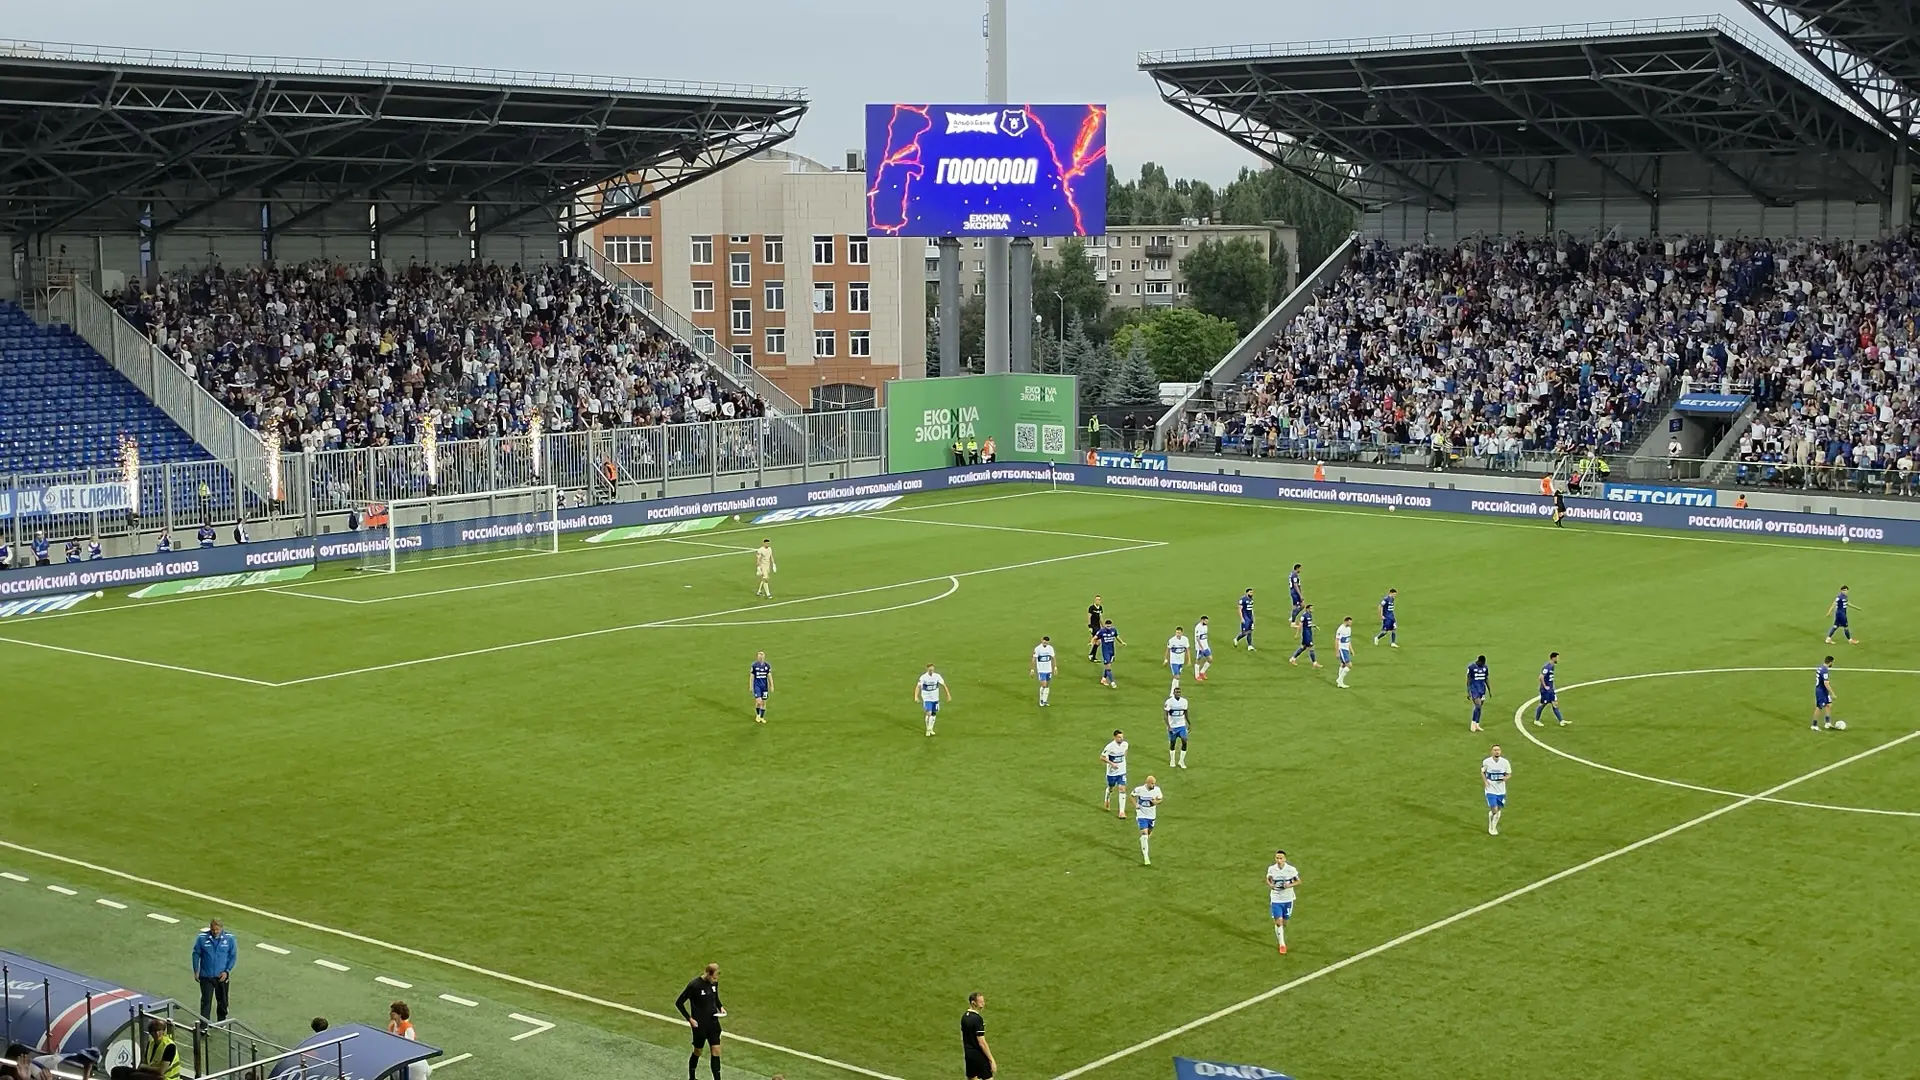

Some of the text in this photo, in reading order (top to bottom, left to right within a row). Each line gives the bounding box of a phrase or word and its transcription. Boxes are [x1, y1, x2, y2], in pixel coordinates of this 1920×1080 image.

[962, 221, 1009, 230] ЭКОНИВА
[969, 214, 1011, 222] EKONIVA
[923, 406, 980, 427] EKONIVA
[915, 422, 976, 443] ЭКОНИВА
[948, 469, 991, 485] РОССИЙСКИЙ
[1053, 471, 1075, 482] СОЮЗ
[1106, 475, 1243, 494] РОССИЙСКИЙ ФУТБОЛЬНЫЙ СОЮЗ
[16, 490, 42, 516] ДУХ
[60, 488, 75, 509] НЕ
[80, 484, 132, 509] СЛОМИТ
[807, 479, 923, 502] РОССИЙСКИЙ ФУТБОЛЬНЫЙ СОЮЗ
[1278, 487, 1432, 507] РОССИЙСКИЙ ФУТБОЛЬНЫЙ СОЮЗ
[1607, 488, 1713, 507] БЕТСИТИ
[647, 495, 778, 520] РОССИЙСКИЙ ФУТБОЛЬНЫЙ СОЮЗ
[1471, 500, 1537, 516] РОССИЙСКИЙ
[1612, 509, 1643, 523] СОЮЗ
[462, 523, 524, 541] РОССИЙСКИЙ
[587, 514, 613, 526] СОЮЗ
[1688, 515, 1884, 540] РОССИЙСКИЙ ФУТБОЛЬНЫЙ СОЮЗ
[79, 563, 164, 585] ФУТБОЛЬНЫЙ
[165, 560, 200, 575] СОЮЗ
